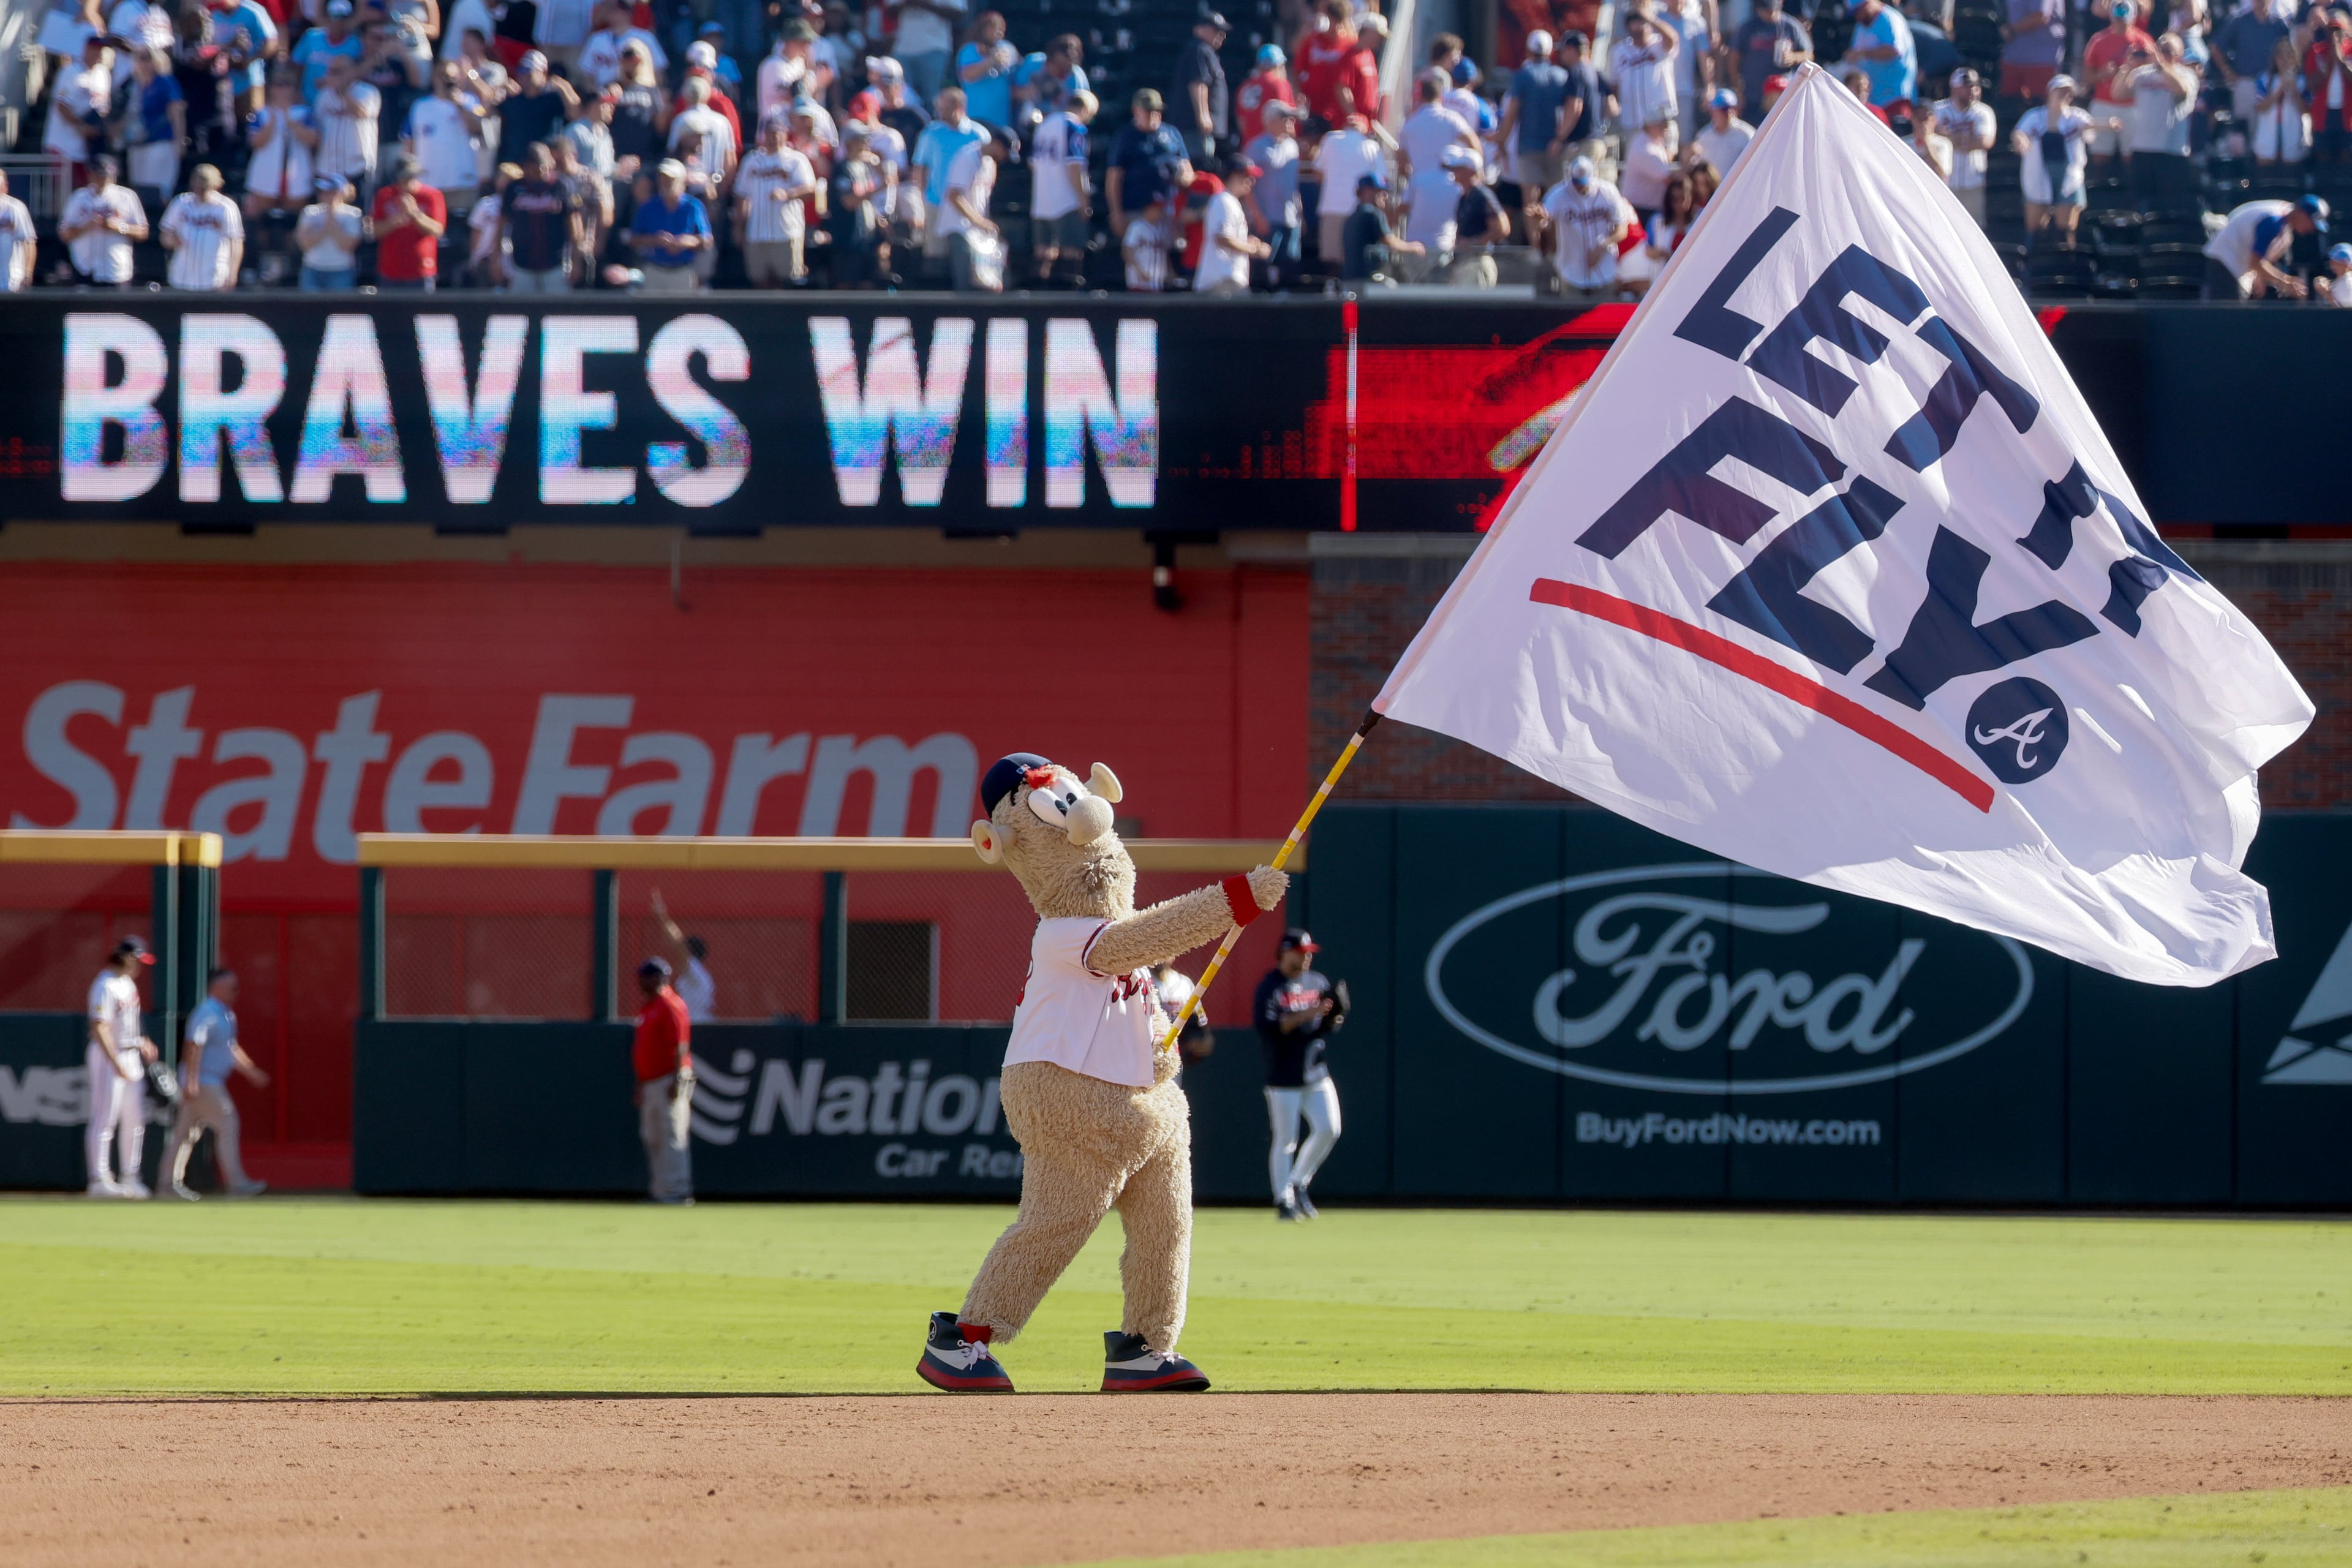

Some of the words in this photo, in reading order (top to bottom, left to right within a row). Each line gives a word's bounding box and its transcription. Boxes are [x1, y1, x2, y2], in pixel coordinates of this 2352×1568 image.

[61, 312, 751, 507] BRAVES
[808, 316, 1158, 508] WIN
[1673, 206, 2040, 473] LET
[1574, 395, 2101, 712] FLY
[9, 679, 495, 864] State
[511, 692, 979, 837] Farm
[1533, 892, 1925, 1054] Ford
[875, 1142, 949, 1178] Car
[1576, 1113, 1880, 1148] BuyFordNow.com
